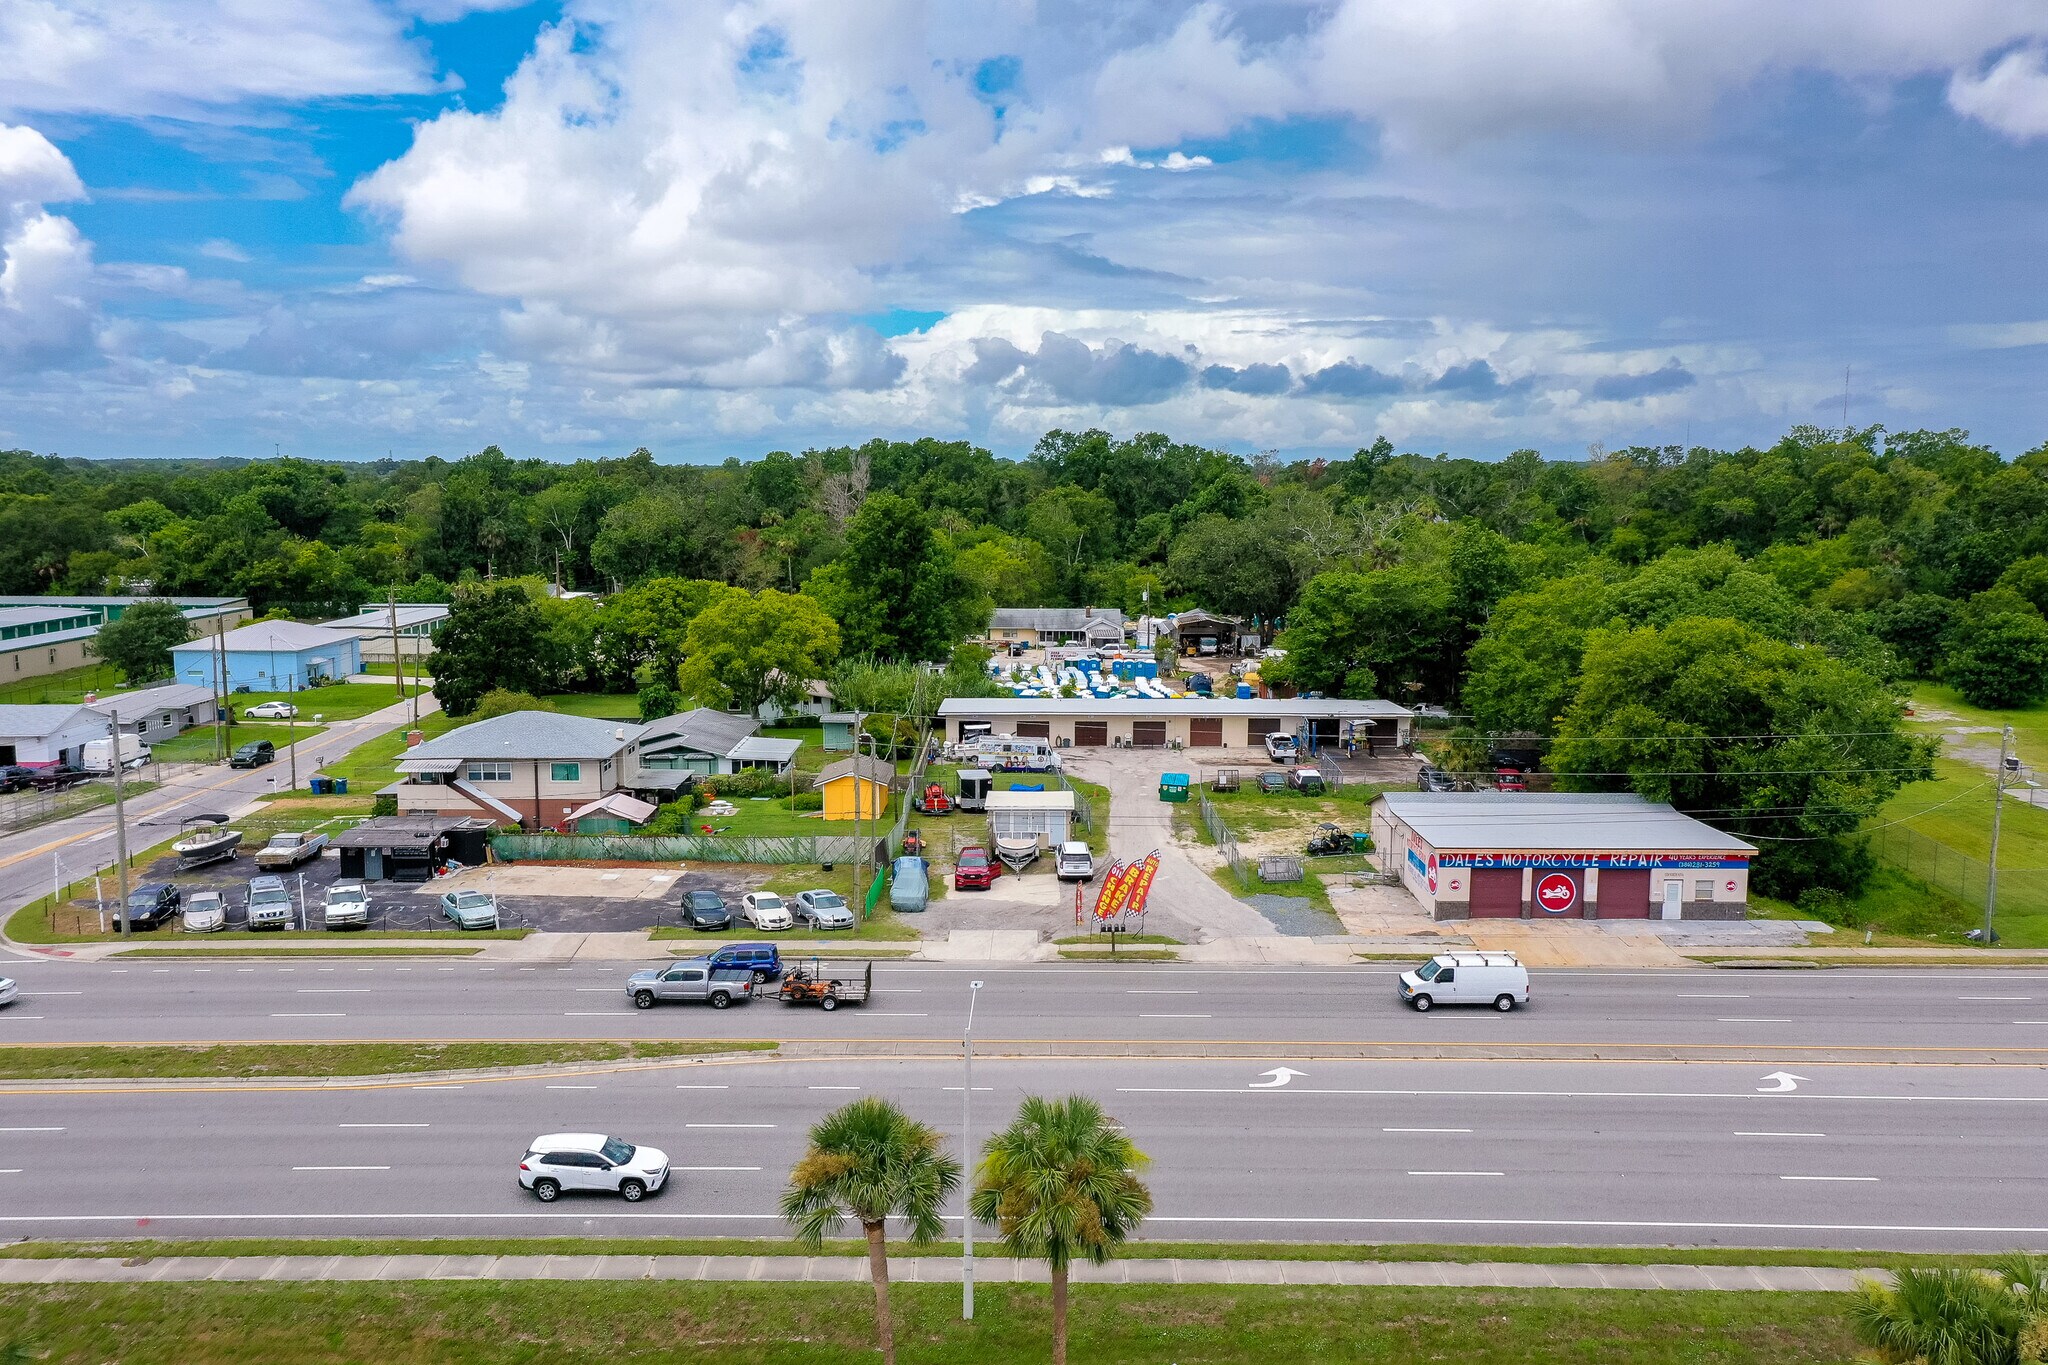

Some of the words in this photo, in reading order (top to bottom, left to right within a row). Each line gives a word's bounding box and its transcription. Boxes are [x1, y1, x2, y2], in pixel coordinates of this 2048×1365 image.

[1146, 858, 1159, 867] AUTO
[1501, 854, 1600, 867] MOTORCYCLE
[1609, 854, 1663, 867] REPAIR
[1097, 876, 1118, 917] CHANGE
[1110, 867, 1140, 909] BRAKE
[1132, 865, 1154, 910] REPAIR
